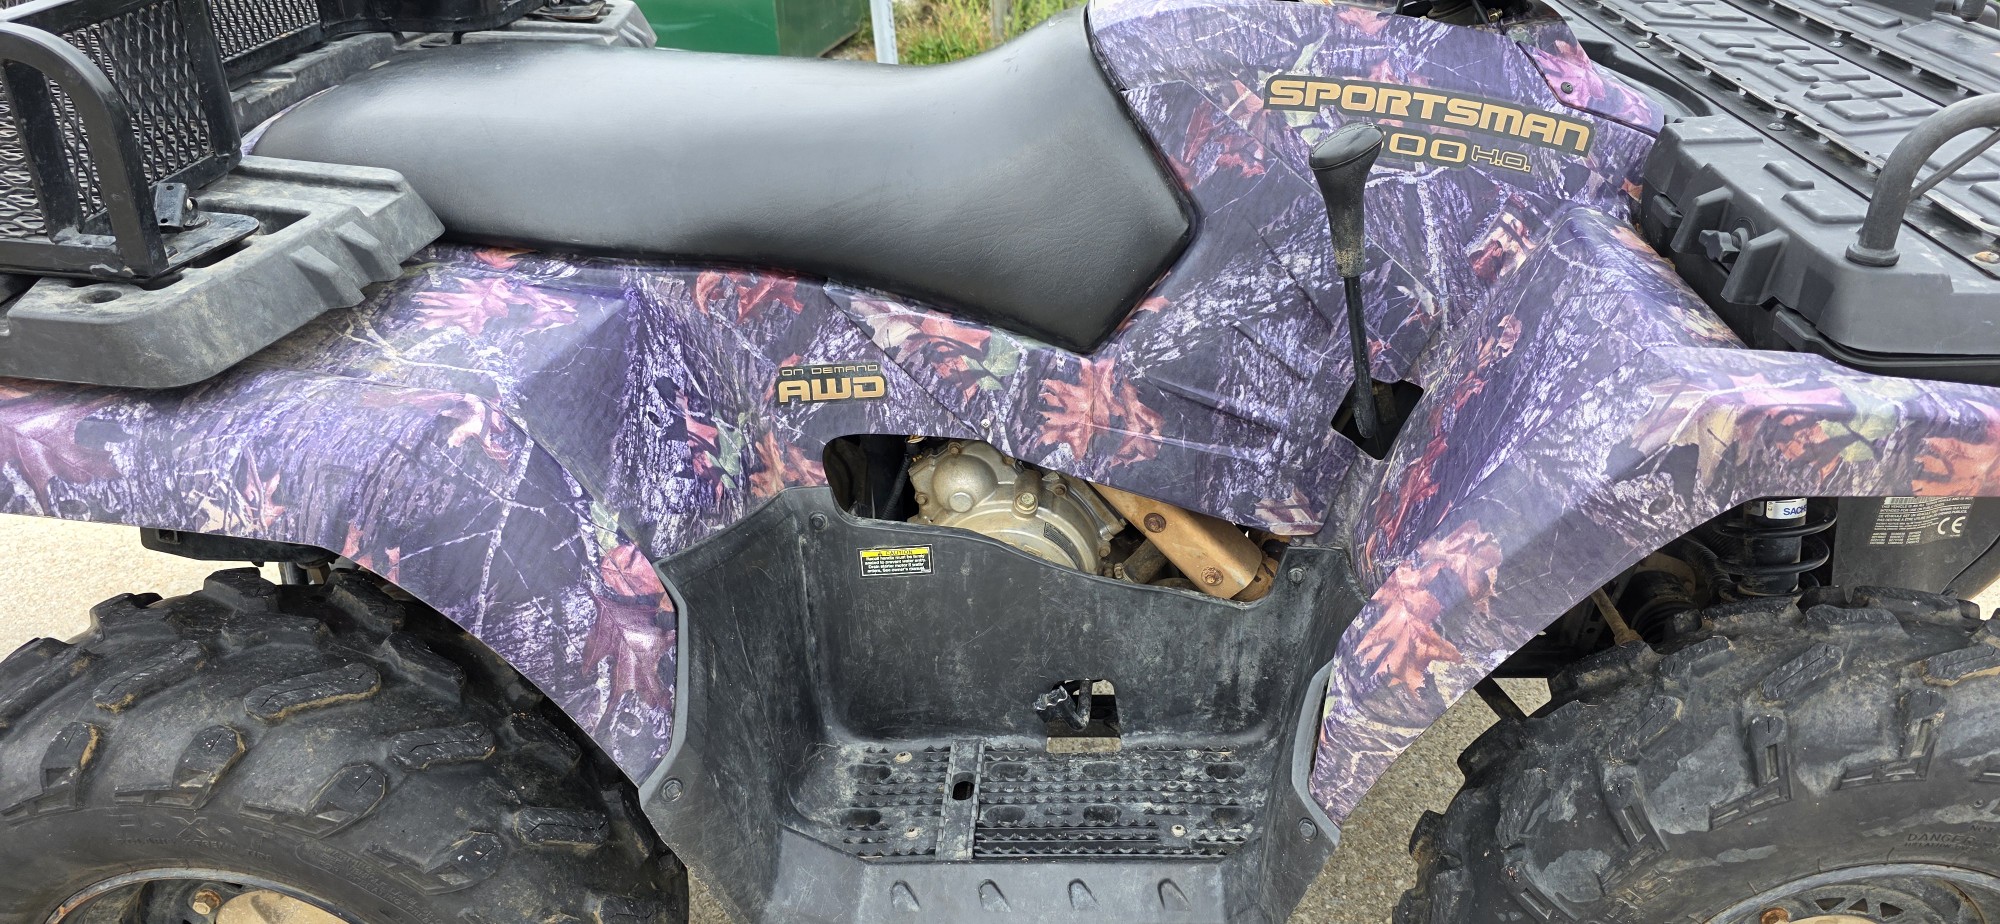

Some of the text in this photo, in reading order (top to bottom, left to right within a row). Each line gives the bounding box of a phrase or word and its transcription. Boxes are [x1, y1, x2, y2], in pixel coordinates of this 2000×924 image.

[1269, 79, 1590, 152] SPORTSMAN
[1379, 132, 1532, 173] 00 H.O.
[781, 364, 878, 377] ON DEMAND
[778, 376, 885, 403] AWD
[1907, 832, 1976, 845] DANGER
